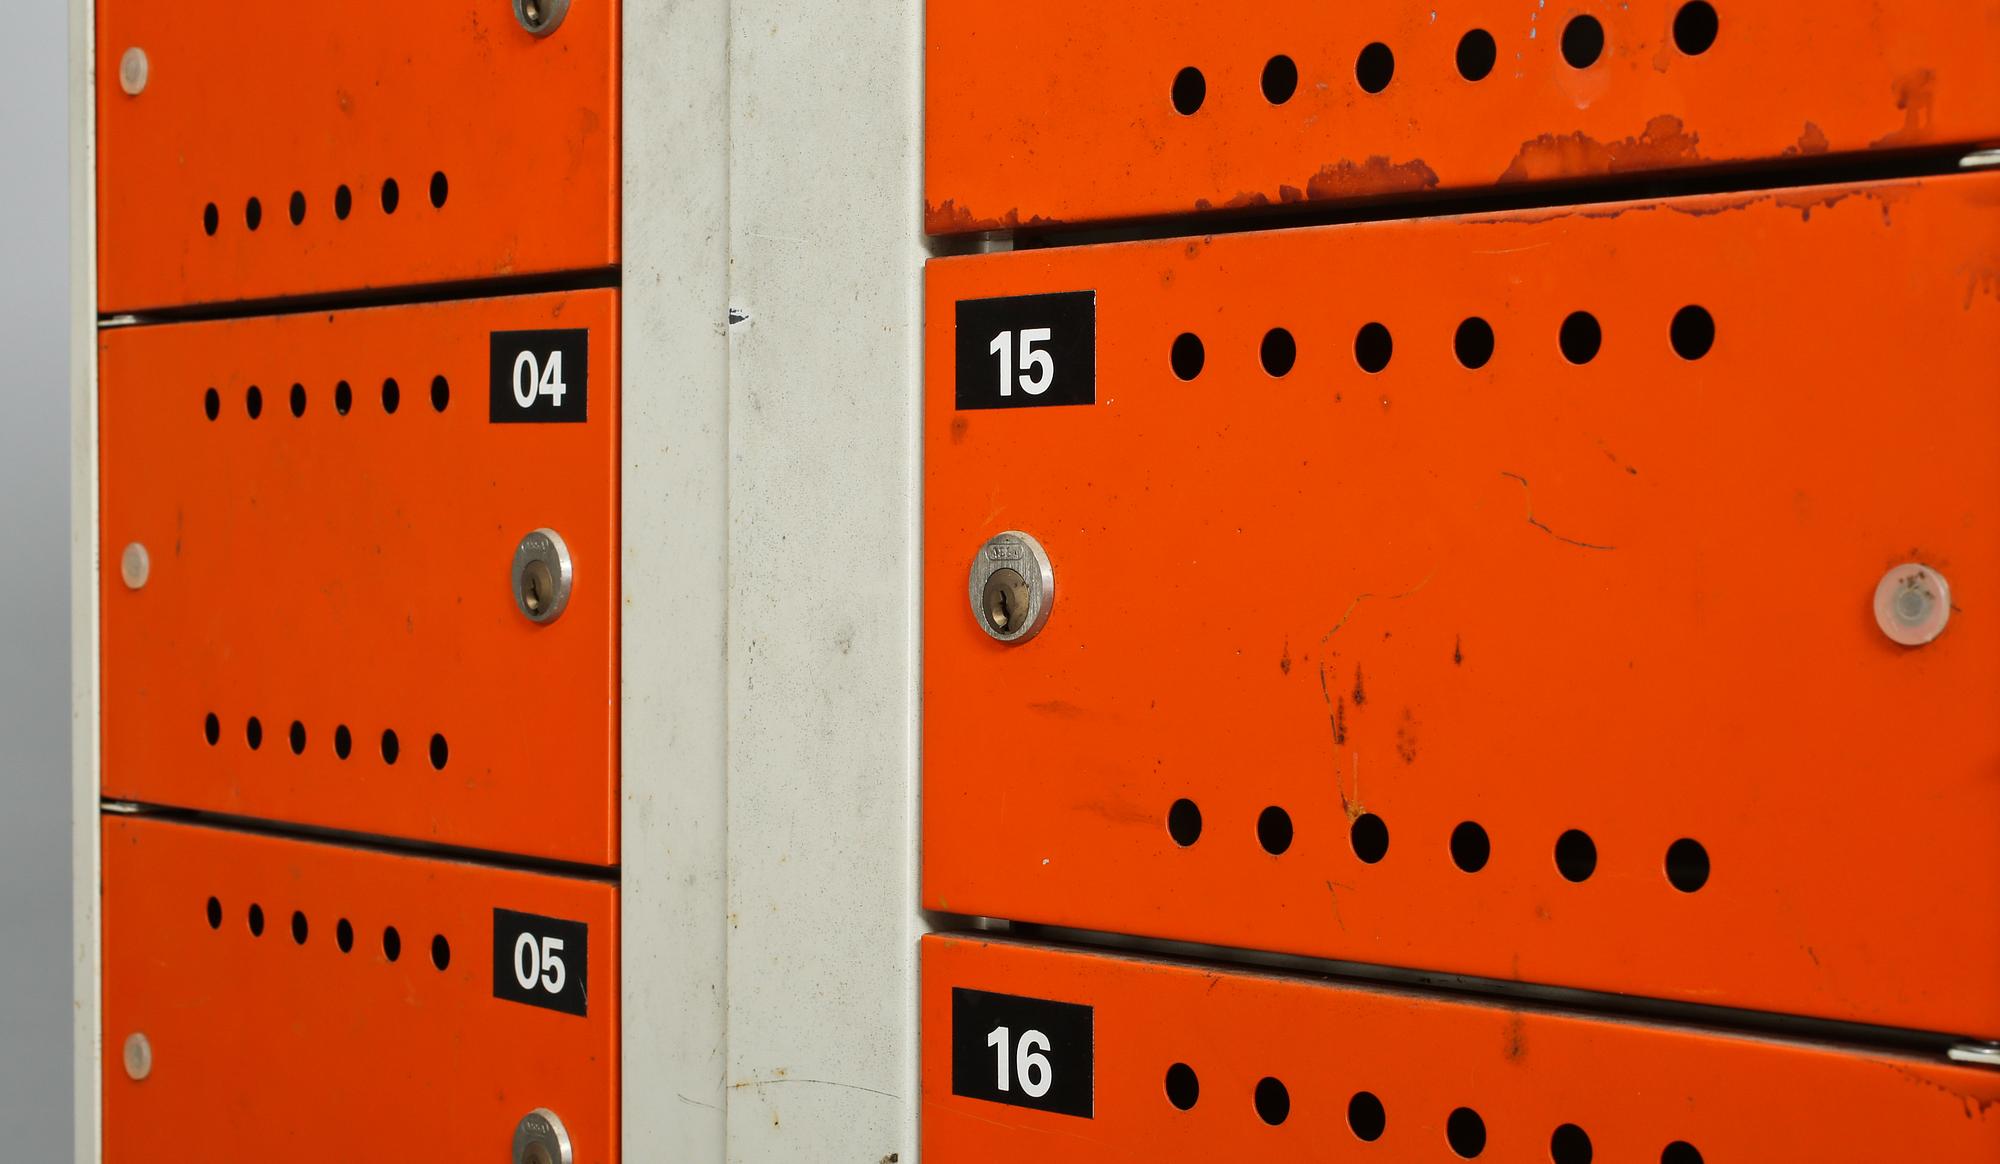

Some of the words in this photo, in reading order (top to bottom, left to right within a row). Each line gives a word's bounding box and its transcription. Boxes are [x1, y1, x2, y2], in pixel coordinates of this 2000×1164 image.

[512, 350, 566, 408] 04
[990, 328, 1053, 396] 15
[514, 932, 566, 993] 05
[988, 1026, 1053, 1097] 16
